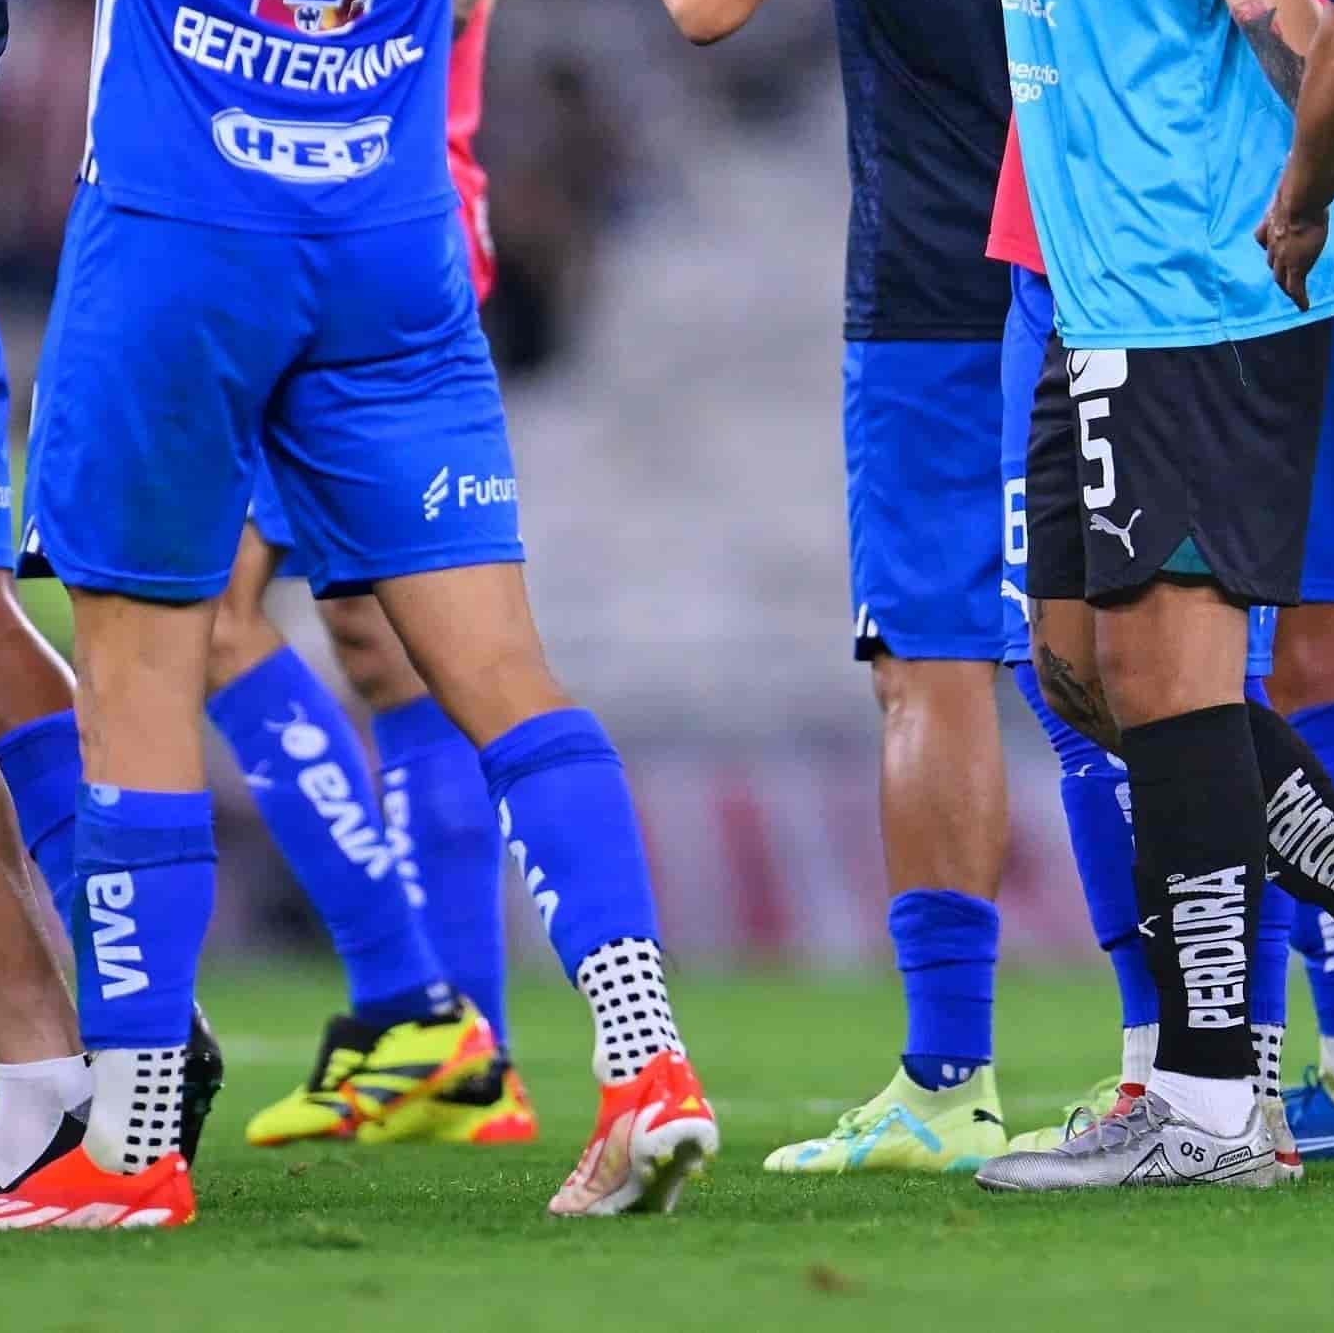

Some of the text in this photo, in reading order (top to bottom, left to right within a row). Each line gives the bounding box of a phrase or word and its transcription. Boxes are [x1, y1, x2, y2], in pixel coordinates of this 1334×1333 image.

[1079, 396, 1116, 509] 5
[87, 871, 150, 1001] viva
[1168, 864, 1247, 1029] PERDURA
[1180, 1141, 1207, 1163] 05
